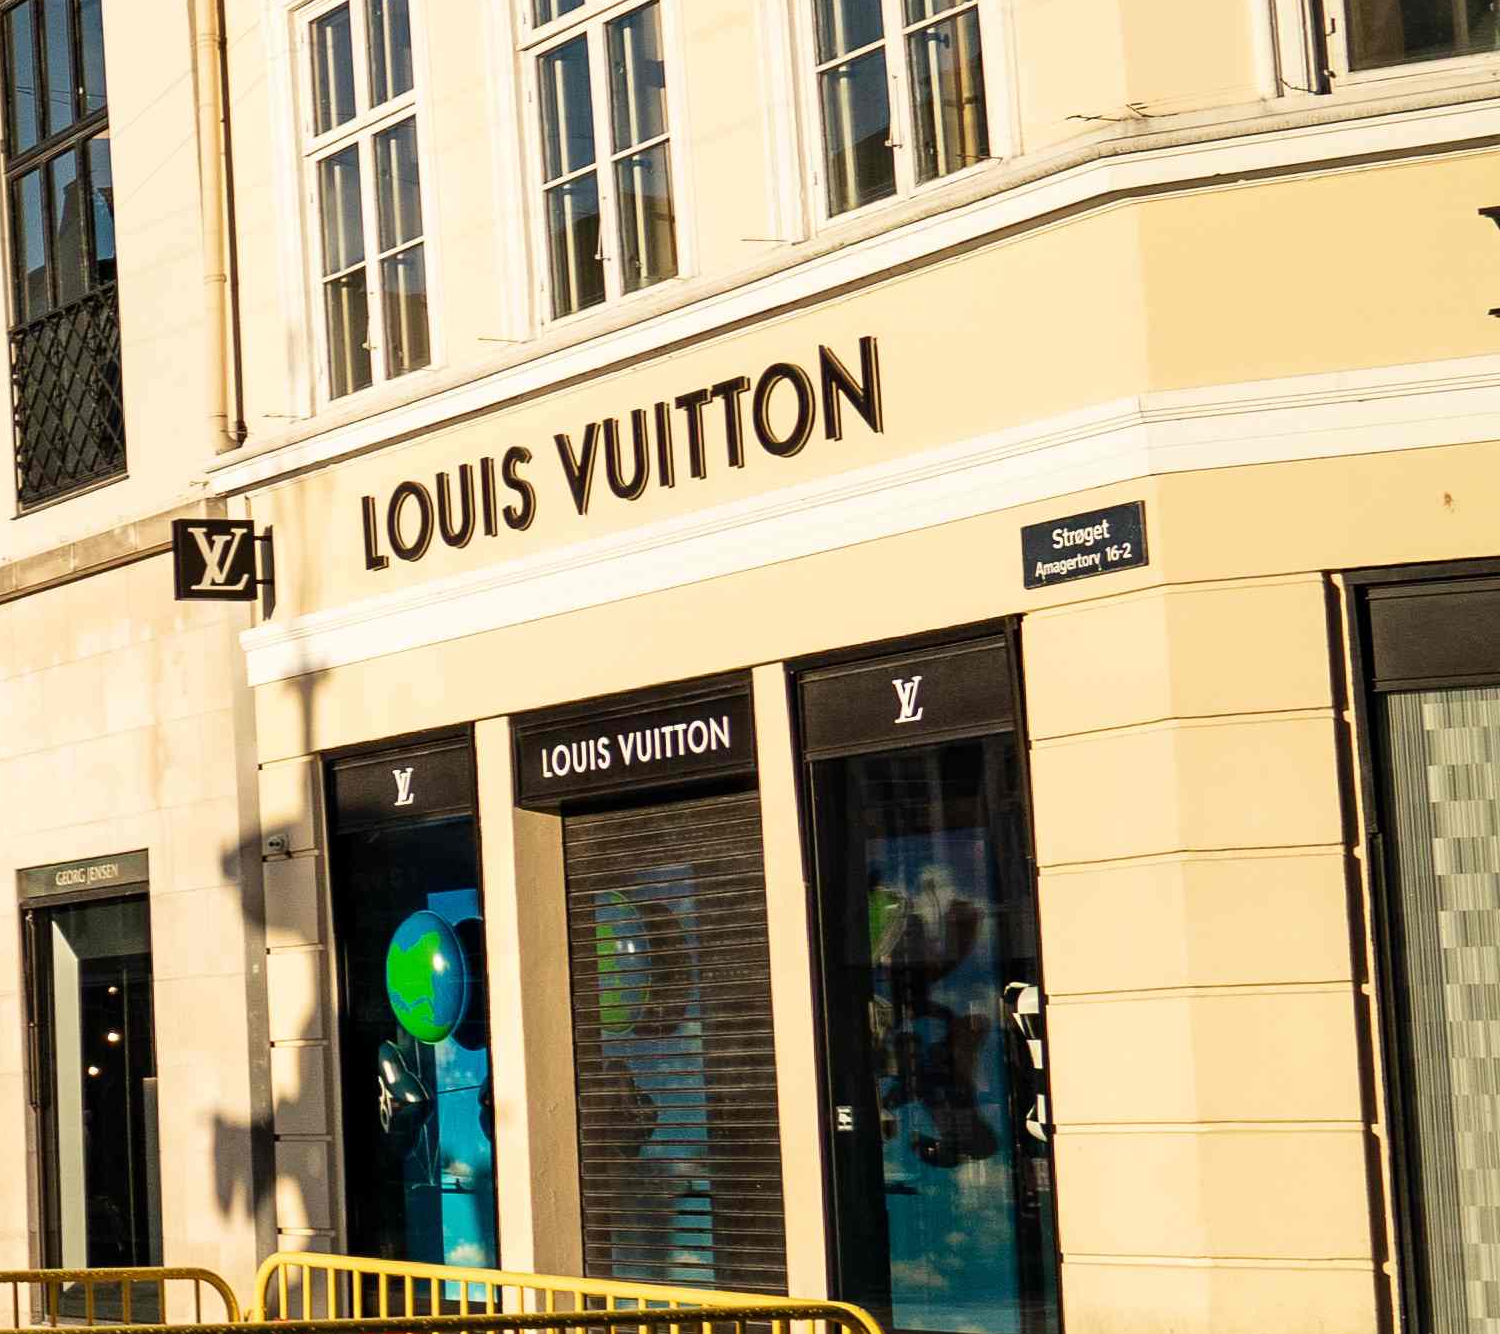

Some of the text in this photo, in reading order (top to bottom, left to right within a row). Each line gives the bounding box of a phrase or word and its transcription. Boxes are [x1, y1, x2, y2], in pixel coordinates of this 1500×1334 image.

[361, 335, 885, 572] LOUIS VUITTON
[1052, 519, 1111, 549] Strøget
[1035, 542, 1132, 578] Amagertorv 16-2
[541, 715, 730, 778] LOUIS VUITTON
[55, 864, 118, 886] GEORG JENSEN
